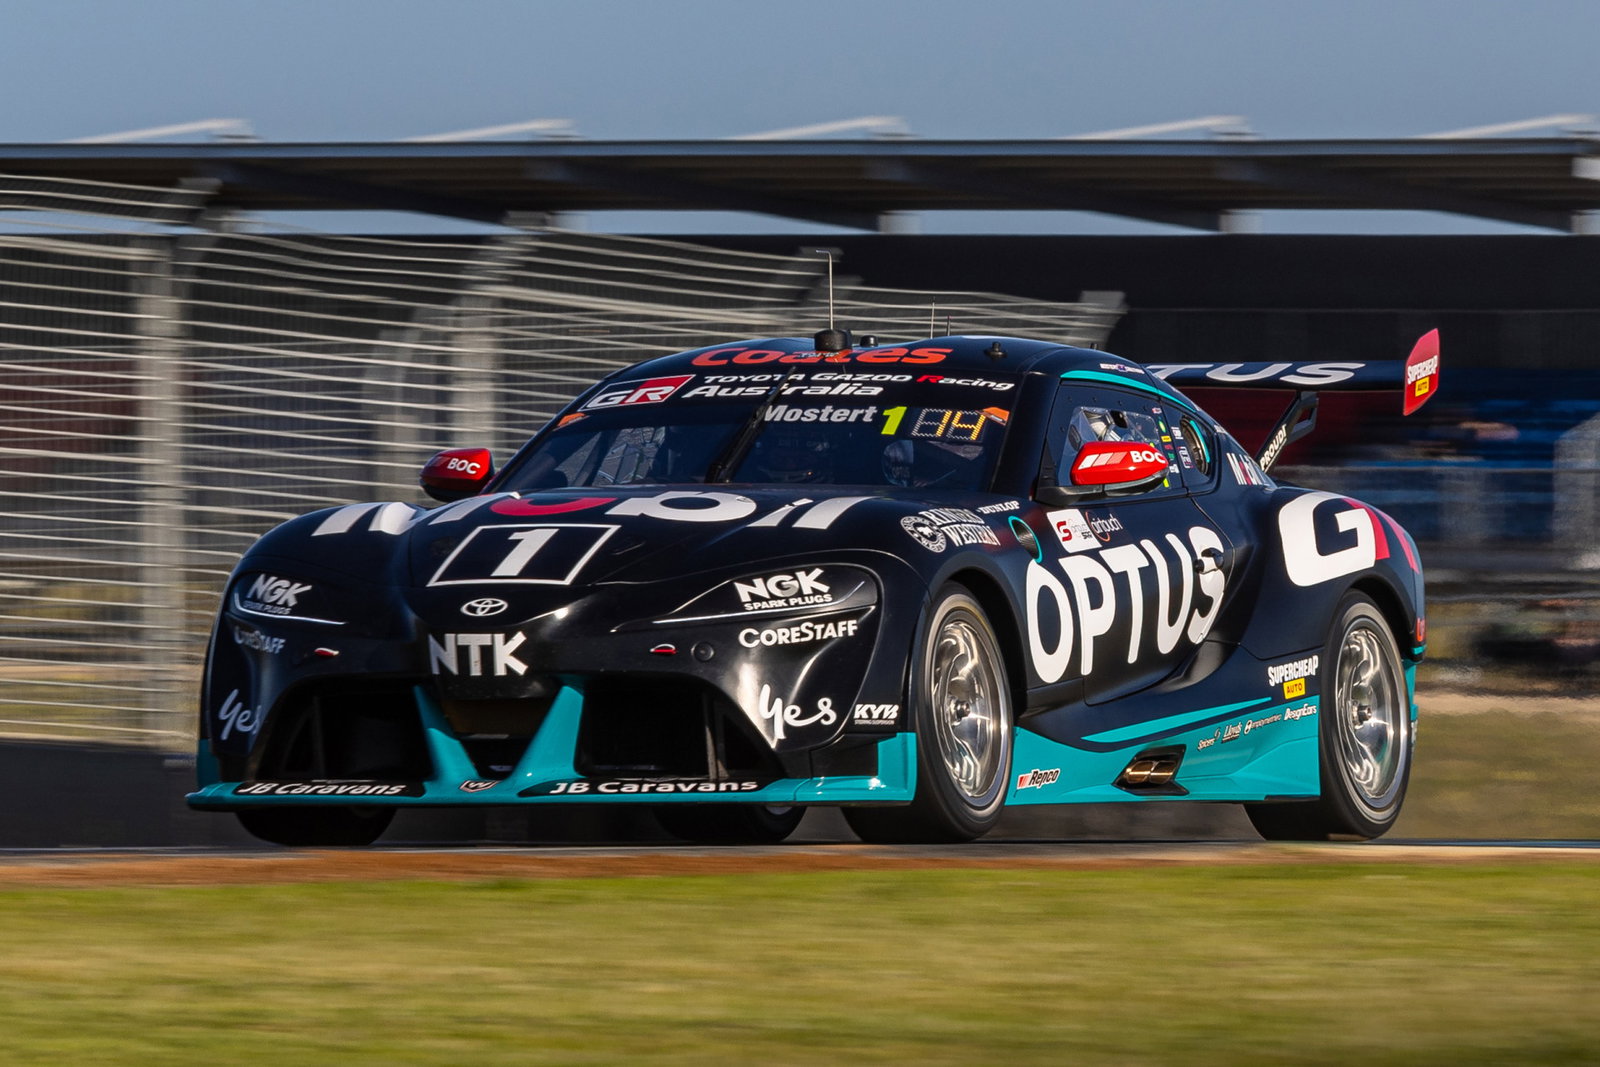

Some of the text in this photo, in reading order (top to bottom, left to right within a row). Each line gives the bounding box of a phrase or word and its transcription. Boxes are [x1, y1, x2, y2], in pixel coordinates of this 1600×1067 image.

[691, 347, 954, 366] Coates
[1407, 354, 1438, 385] SUPERCHEAP
[704, 372, 1016, 391] TOYOTA GAZOO Racing
[586, 385, 676, 408] GR
[764, 405, 908, 436] Mostert 1
[447, 457, 481, 475] BOC
[1129, 450, 1166, 464] BOC
[918, 507, 985, 526] RINGERS
[977, 500, 1020, 514] DUNLOP
[940, 523, 1001, 547] WESTERN
[490, 528, 560, 577] 1
[246, 573, 313, 607] NGK
[733, 567, 830, 602] NGK
[743, 593, 833, 611] SPARK PLUGS
[1026, 526, 1226, 684] OPTUS
[428, 631, 529, 676] NTK
[1267, 654, 1319, 687] SUPERCHEAP
[1286, 682, 1303, 695] AUTO
[853, 703, 900, 719] KYB
[549, 781, 760, 794] JB Caravans
[1028, 769, 1060, 788] Repco
[237, 782, 407, 795] JB Caravans
